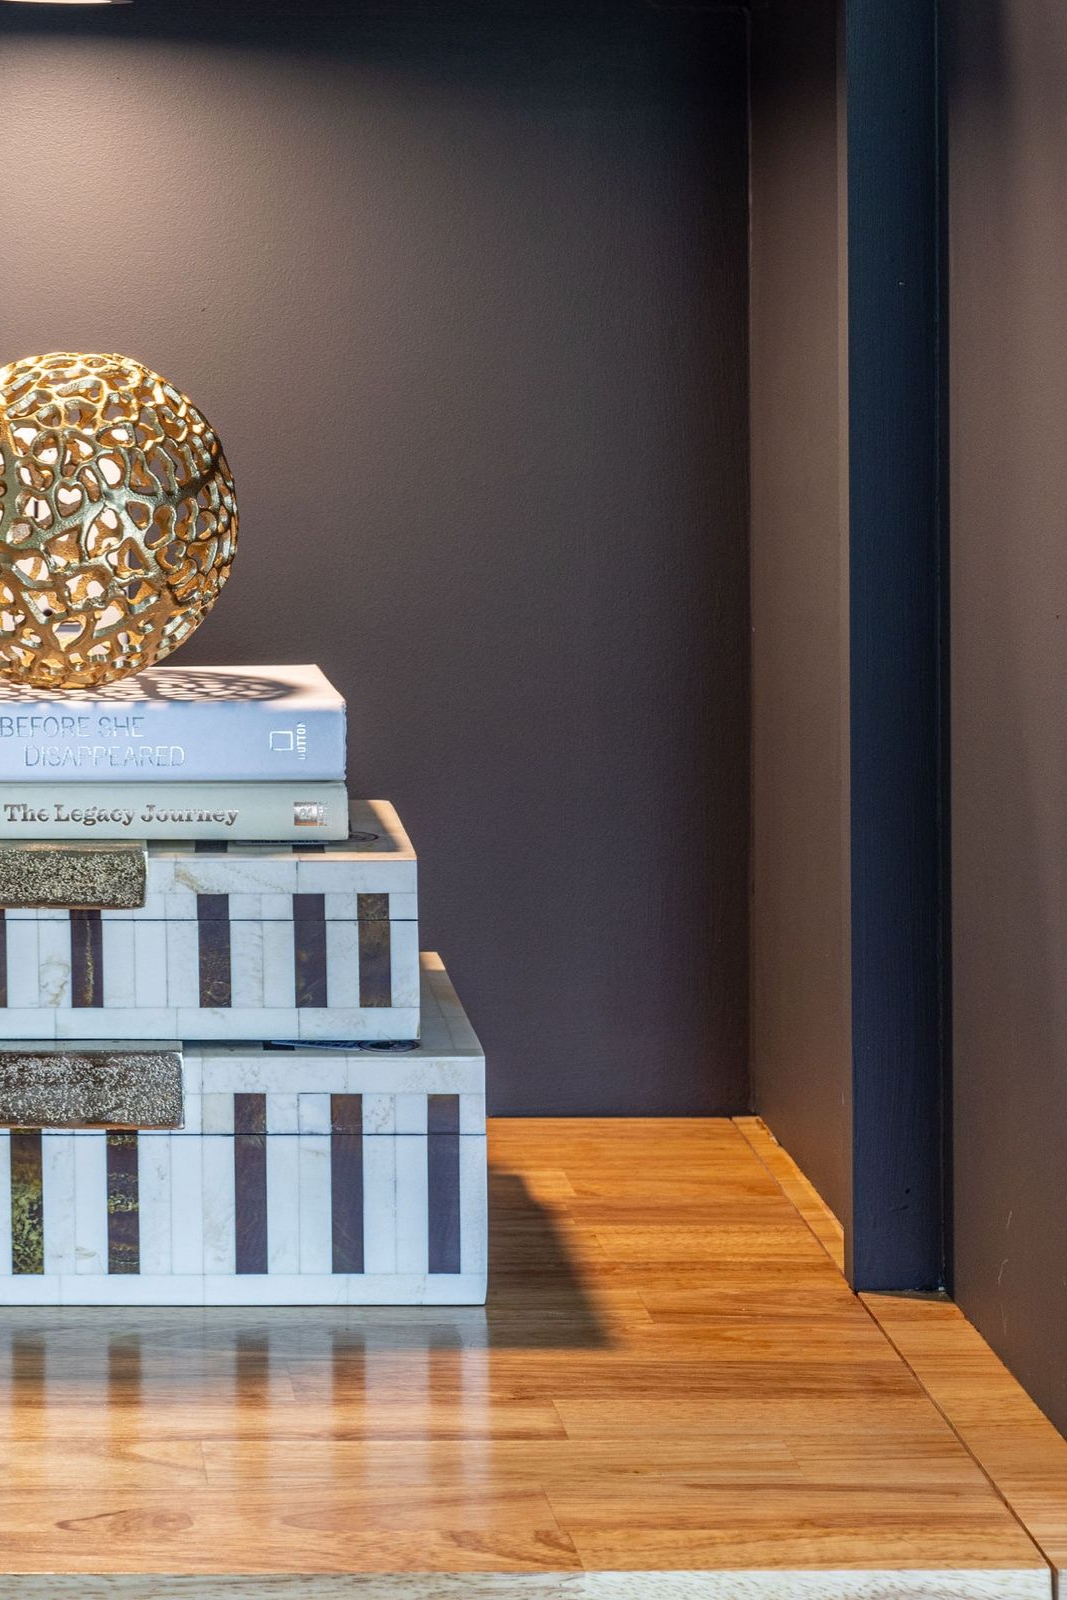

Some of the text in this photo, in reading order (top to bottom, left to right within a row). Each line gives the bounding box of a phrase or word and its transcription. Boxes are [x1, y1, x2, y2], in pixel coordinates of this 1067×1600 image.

[0, 716, 145, 738] BEFORE SHE
[24, 746, 185, 767] DISAPPEARED
[3, 803, 241, 826] The Legacy Journey
